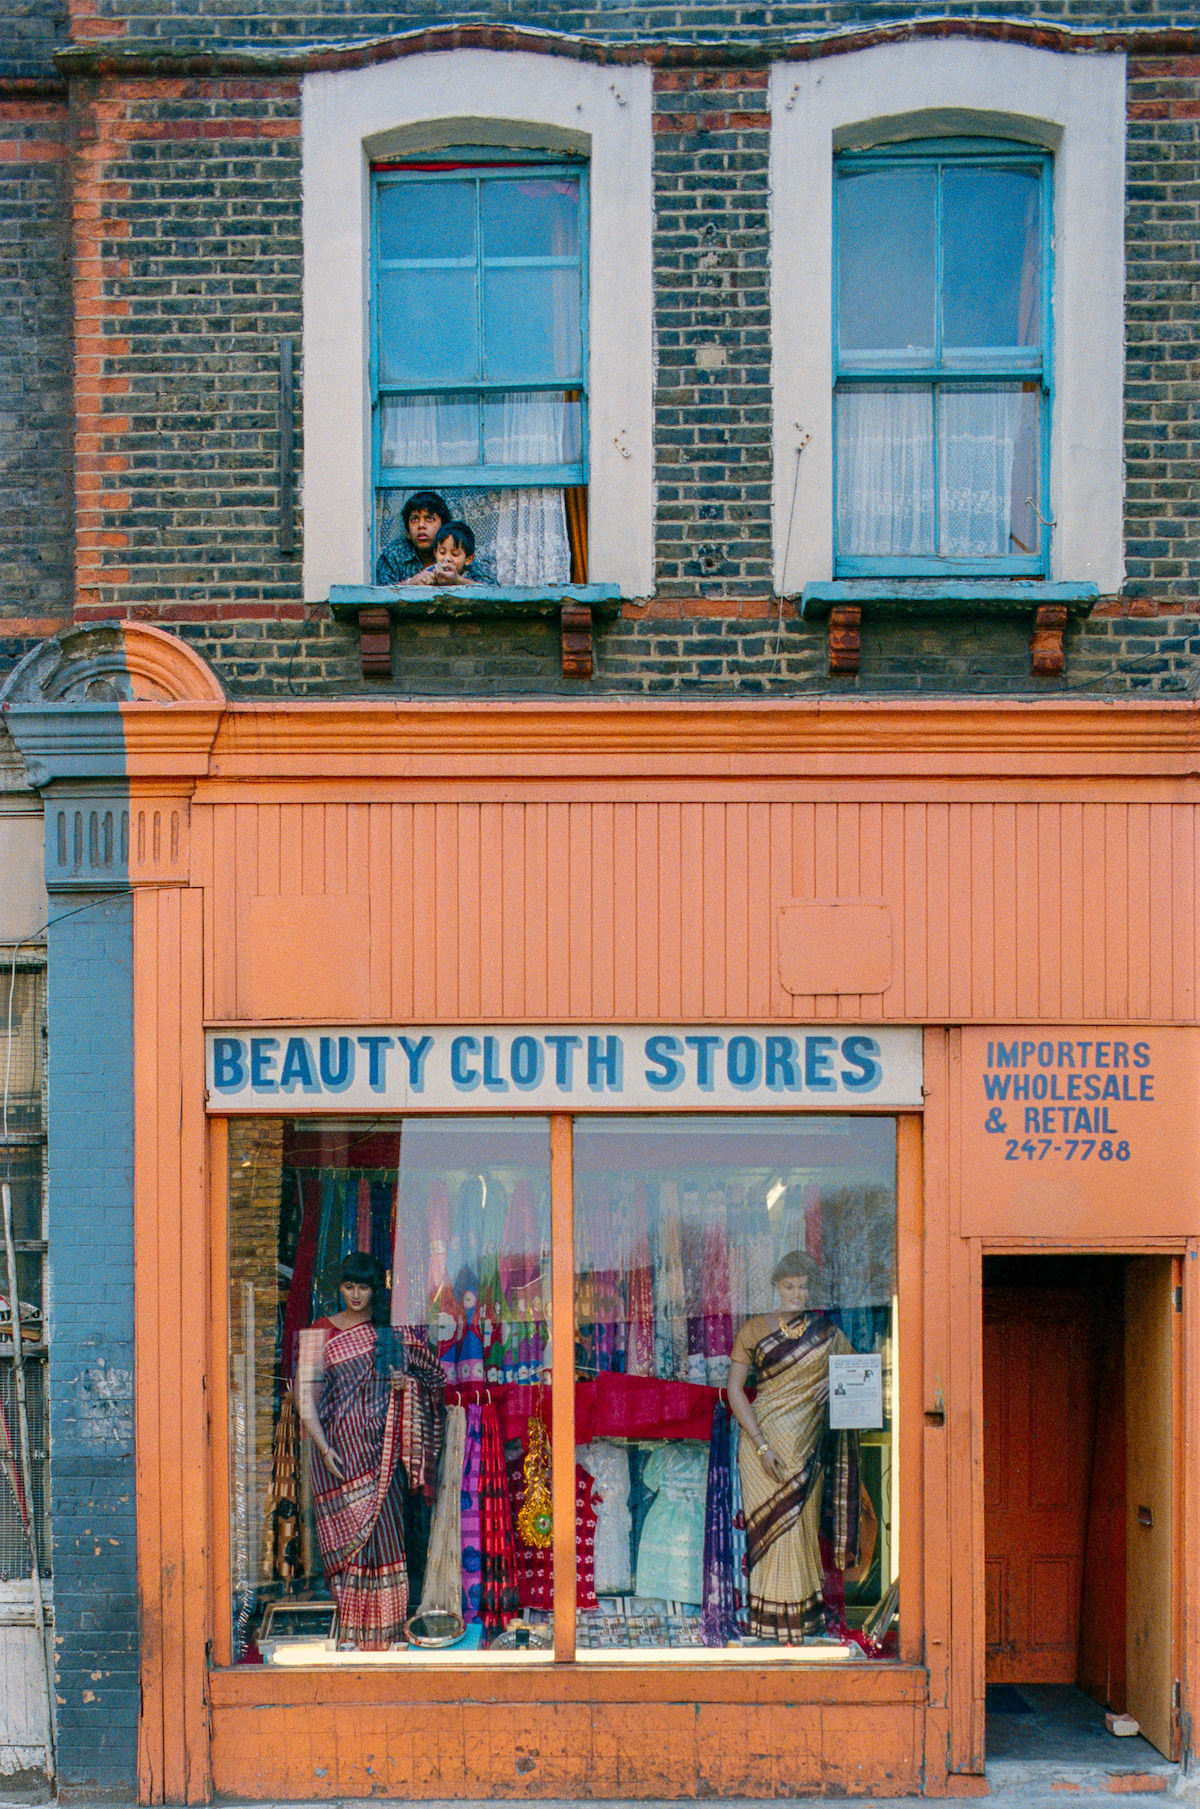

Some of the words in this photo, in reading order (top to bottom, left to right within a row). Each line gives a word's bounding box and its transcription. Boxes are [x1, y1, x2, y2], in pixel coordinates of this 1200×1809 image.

[213, 1036, 434, 1091] BEAUTY
[450, 1036, 620, 1091] CLOTH
[645, 1036, 881, 1091] STORES
[987, 1041, 1151, 1068] IMPORTERS
[982, 1073, 1155, 1101] WHOLESALE
[984, 1106, 1008, 1134] &
[1024, 1106, 1118, 1134] RETAIL
[1005, 1138, 1131, 1161] 247-7788
